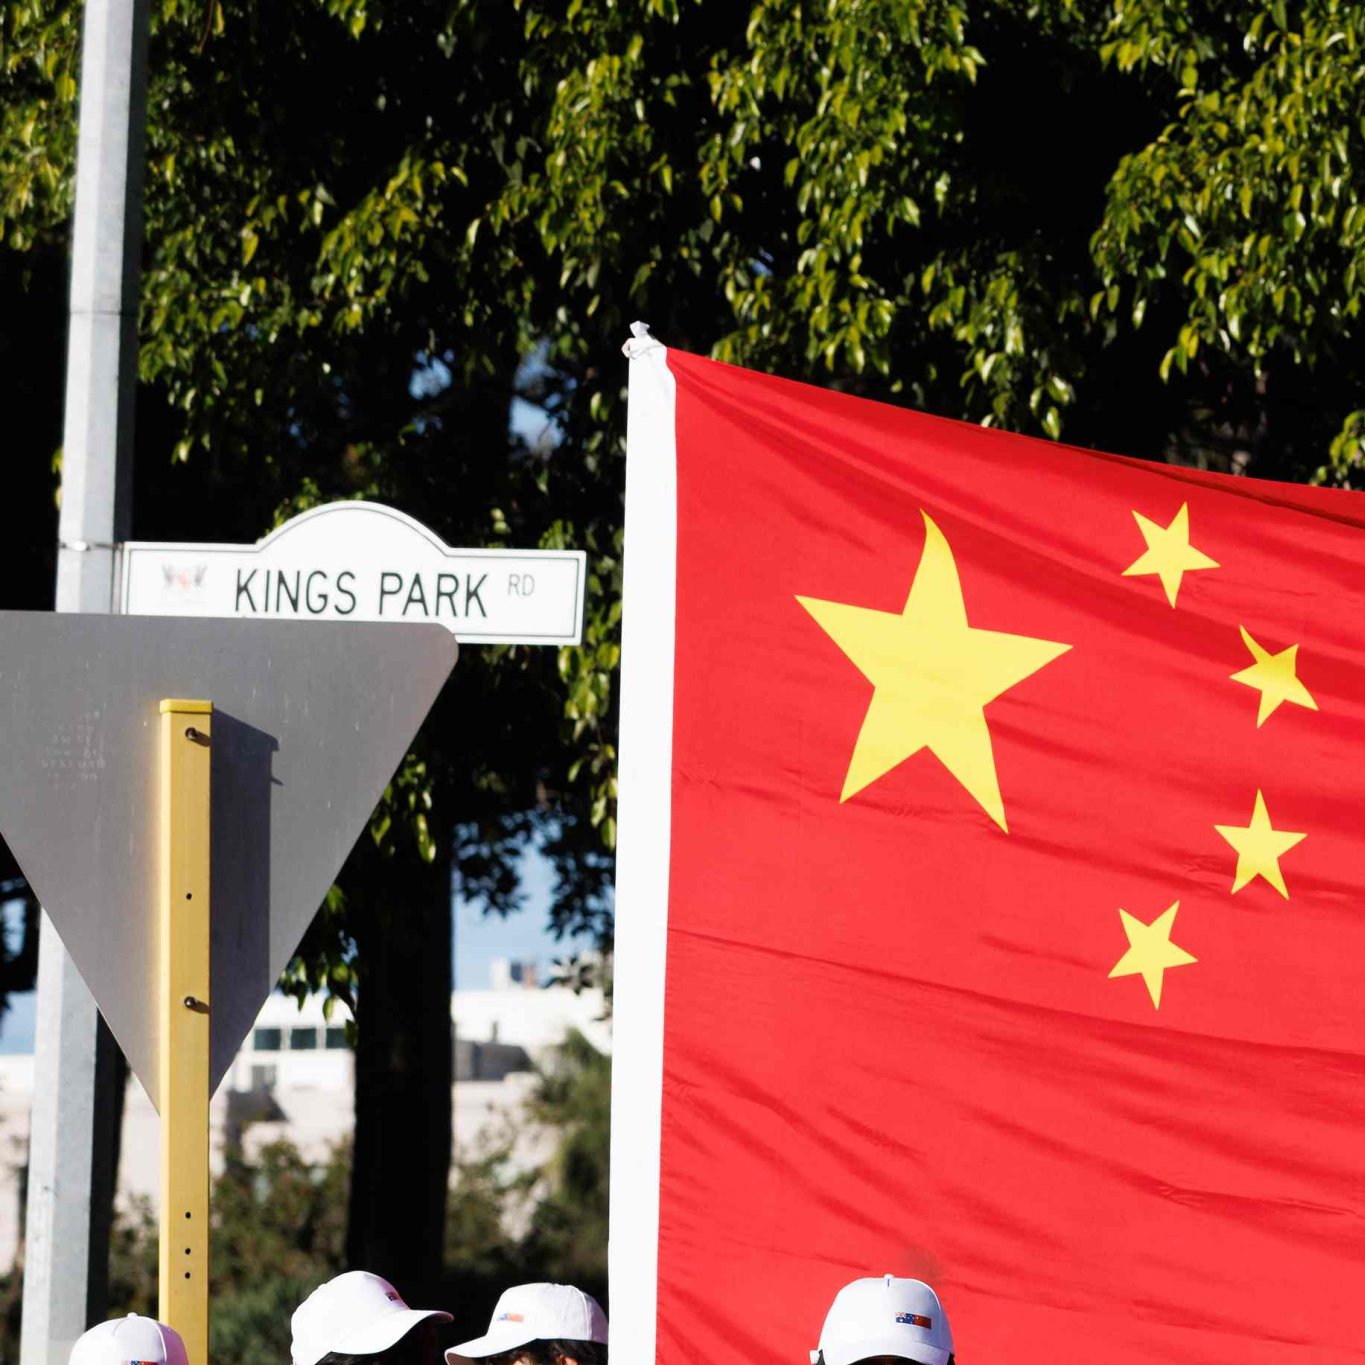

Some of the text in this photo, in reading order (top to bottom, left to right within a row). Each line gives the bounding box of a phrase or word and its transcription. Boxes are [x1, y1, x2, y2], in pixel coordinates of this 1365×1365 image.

[235, 569, 536, 618] KINGS PARK RD
